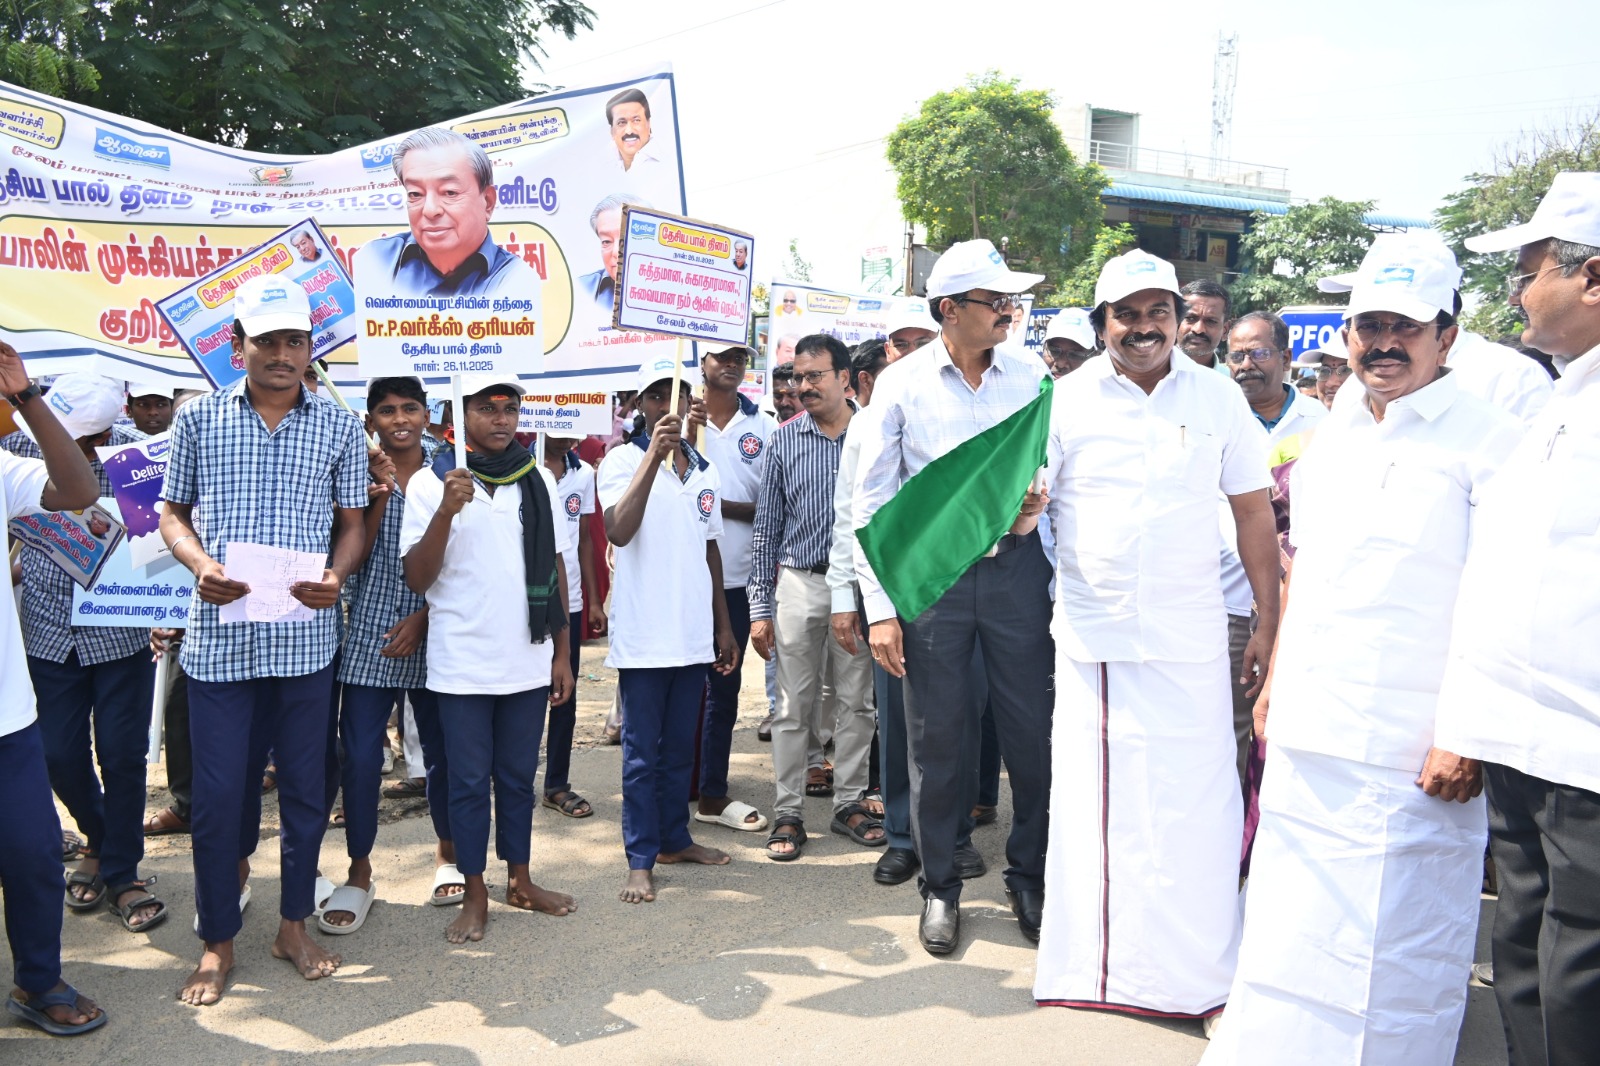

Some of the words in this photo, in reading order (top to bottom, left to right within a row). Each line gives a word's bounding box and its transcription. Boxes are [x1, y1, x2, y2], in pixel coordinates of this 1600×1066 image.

[12, 145, 66, 170] சேலம்
[97, 136, 167, 159] ஆவின்
[0, 167, 46, 201] சிய
[52, 178, 110, 203] பால்
[120, 185, 193, 212] தினம்
[0, 227, 90, 272] பாலின்
[662, 226, 688, 244] தேசிய
[690, 234, 707, 247] பால்
[707, 238, 729, 252] தினம்
[202, 278, 239, 303] தேசிய
[237, 263, 262, 285] பால்
[260, 248, 288, 274] தினம்
[365, 295, 490, 312] வெண்மைப்புரட்சியின்
[492, 296, 533, 313] தந்தை
[629, 286, 677, 306] சுவையான
[677, 292, 692, 310] நம்
[692, 296, 719, 313] ஆவின்
[366, 313, 463, 338] Dr.P.வர்கீஸ்
[467, 316, 535, 340] குரியன்
[656, 314, 686, 329] சேலம்
[688, 319, 719, 333] ஆவின்
[196, 323, 235, 355] விவசாயி
[401, 342, 440, 358] தேசிய
[443, 342, 468, 355] பால்
[470, 342, 503, 357] தினம்
[413, 359, 440, 373] நாள்:
[443, 360, 494, 372] 26.11.2025
[535, 407, 554, 416] பால்
[555, 407, 580, 418] தினம்
[534, 420, 573, 429] 26.11.2025
[131, 463, 166, 481] Delite
[94, 582, 174, 596] அன்னையின்
[79, 600, 167, 621] இணையானது
